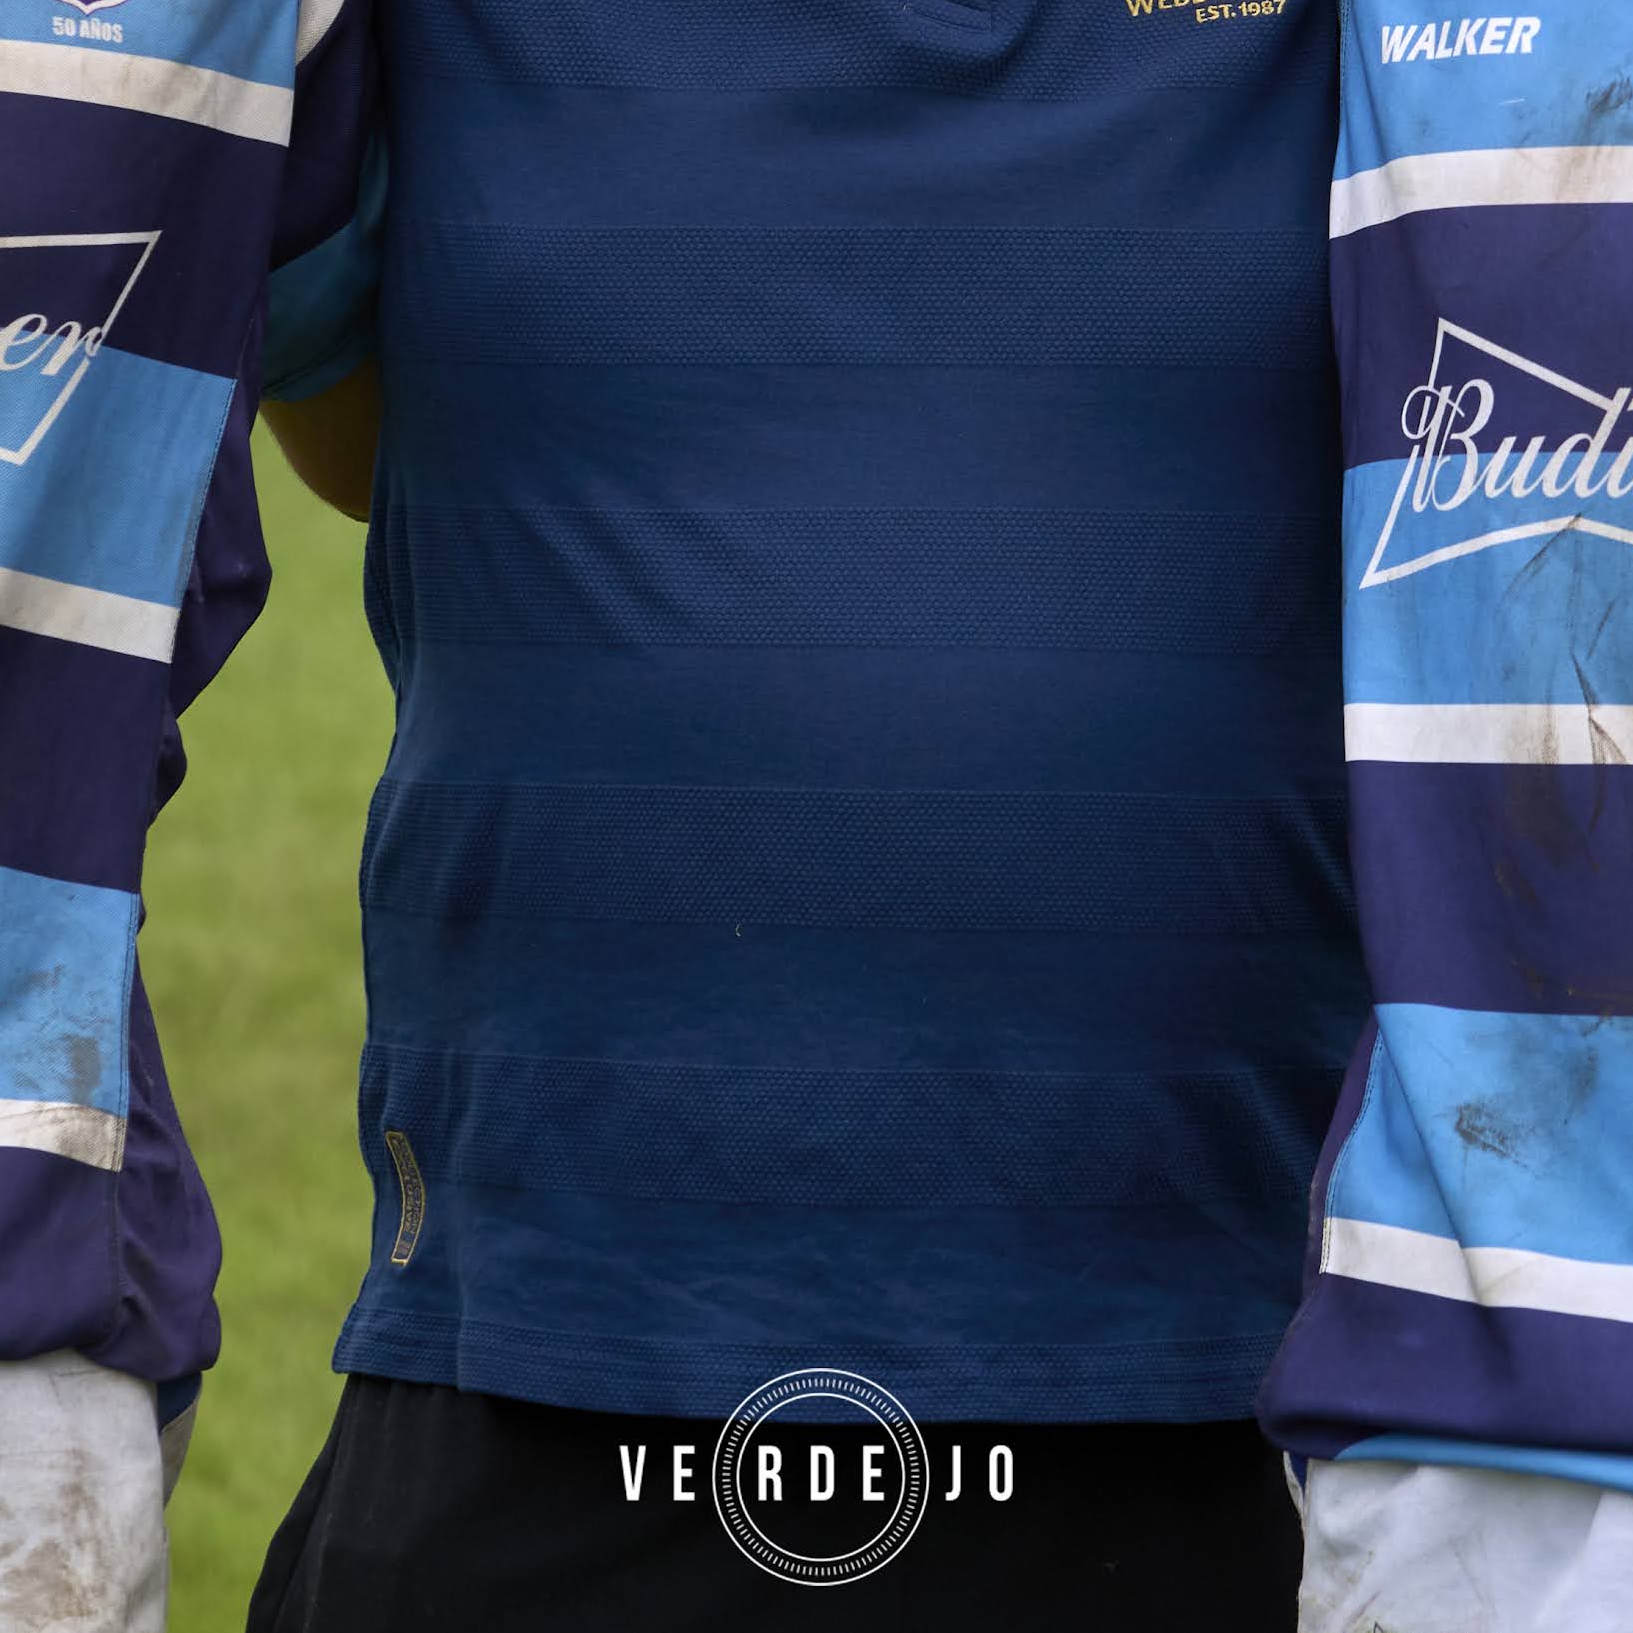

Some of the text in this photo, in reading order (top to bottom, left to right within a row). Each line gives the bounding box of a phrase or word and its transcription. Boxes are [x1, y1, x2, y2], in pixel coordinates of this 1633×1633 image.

[52, 16, 124, 44] 50 AÑOS
[1381, 16, 1542, 64] WALKER
